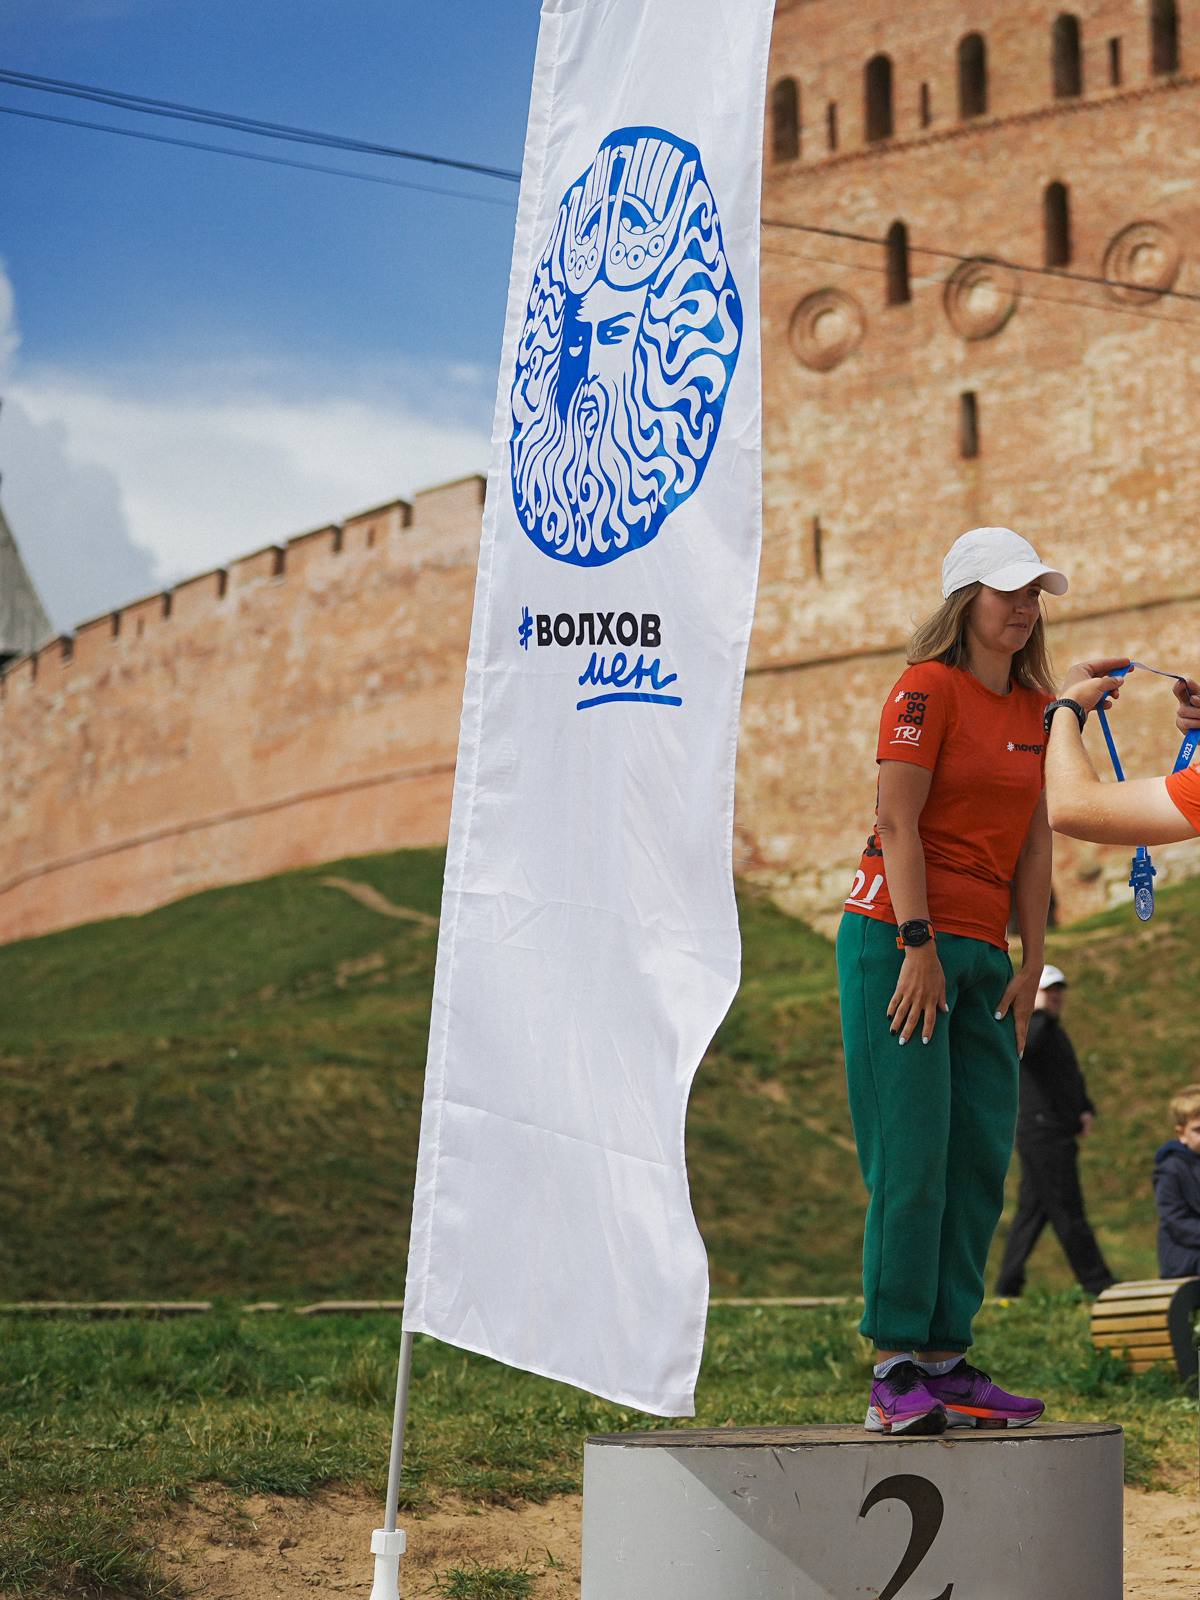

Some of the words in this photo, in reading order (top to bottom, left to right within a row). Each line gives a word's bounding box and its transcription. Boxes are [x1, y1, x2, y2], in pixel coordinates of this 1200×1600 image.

[518, 606, 661, 650] #ВОЛХОВ
[578, 652, 677, 690] мен
[894, 691, 930, 703] #nov
[906, 701, 926, 714] go
[898, 711, 925, 726] rod
[893, 726, 922, 741] TRI
[1182, 743, 1193, 760] 2023
[859, 1474, 954, 1600] 2
